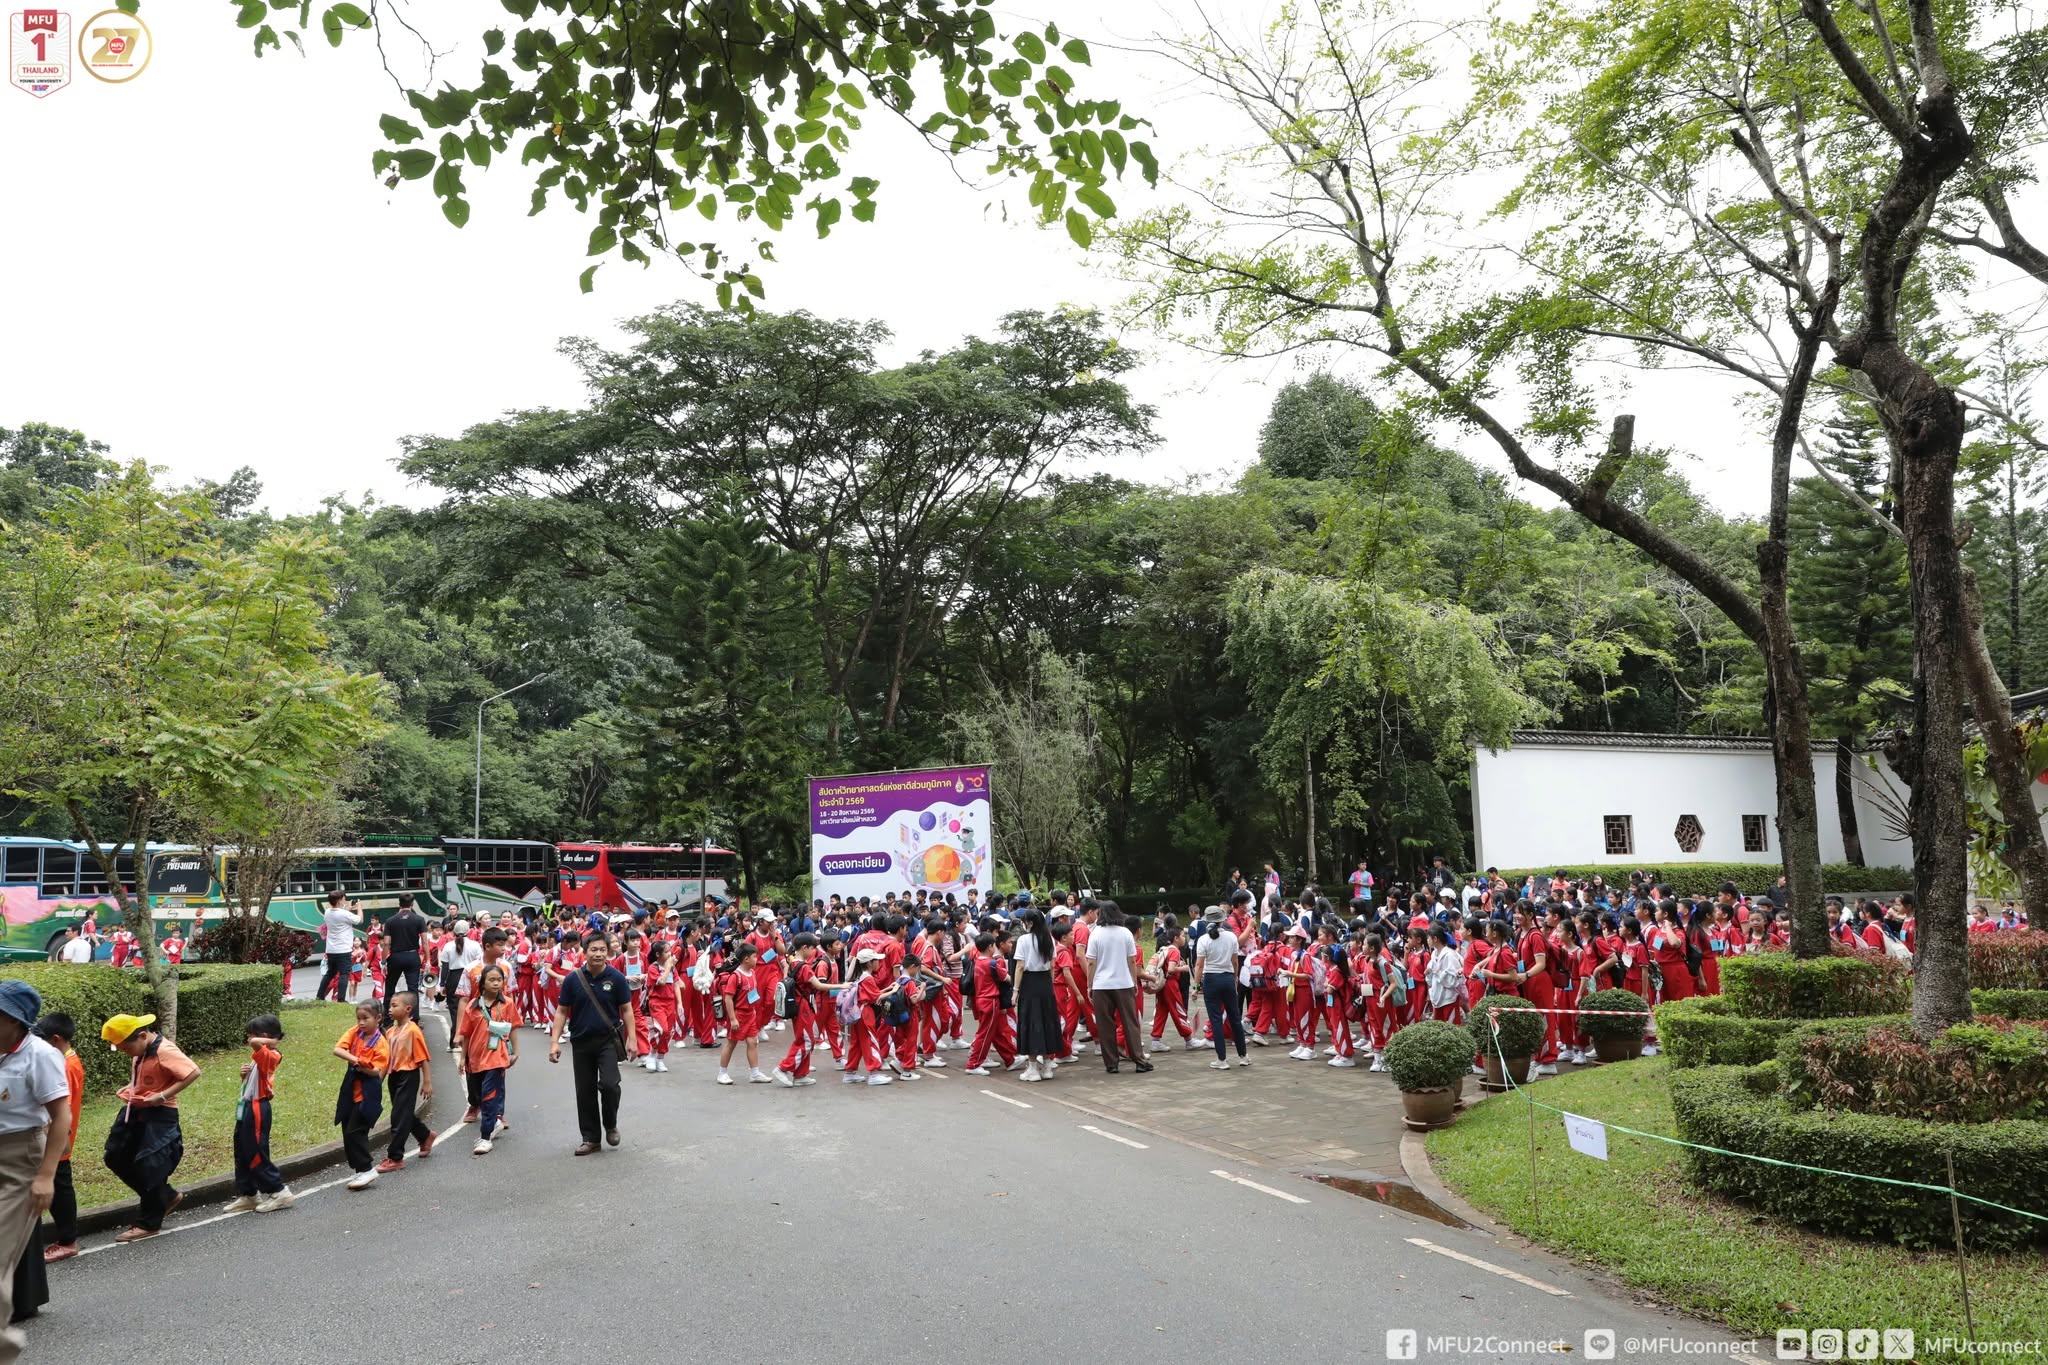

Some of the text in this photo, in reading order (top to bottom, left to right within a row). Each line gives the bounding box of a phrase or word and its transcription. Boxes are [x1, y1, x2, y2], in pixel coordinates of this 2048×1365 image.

[818, 779, 952, 797] สัปดาห์วิทยาศาสตร์แห่งชาติส่วนภูมิภาค
[819, 797, 865, 808] ประจำปี 2569
[825, 856, 885, 873] จุดลงทะเบียน
